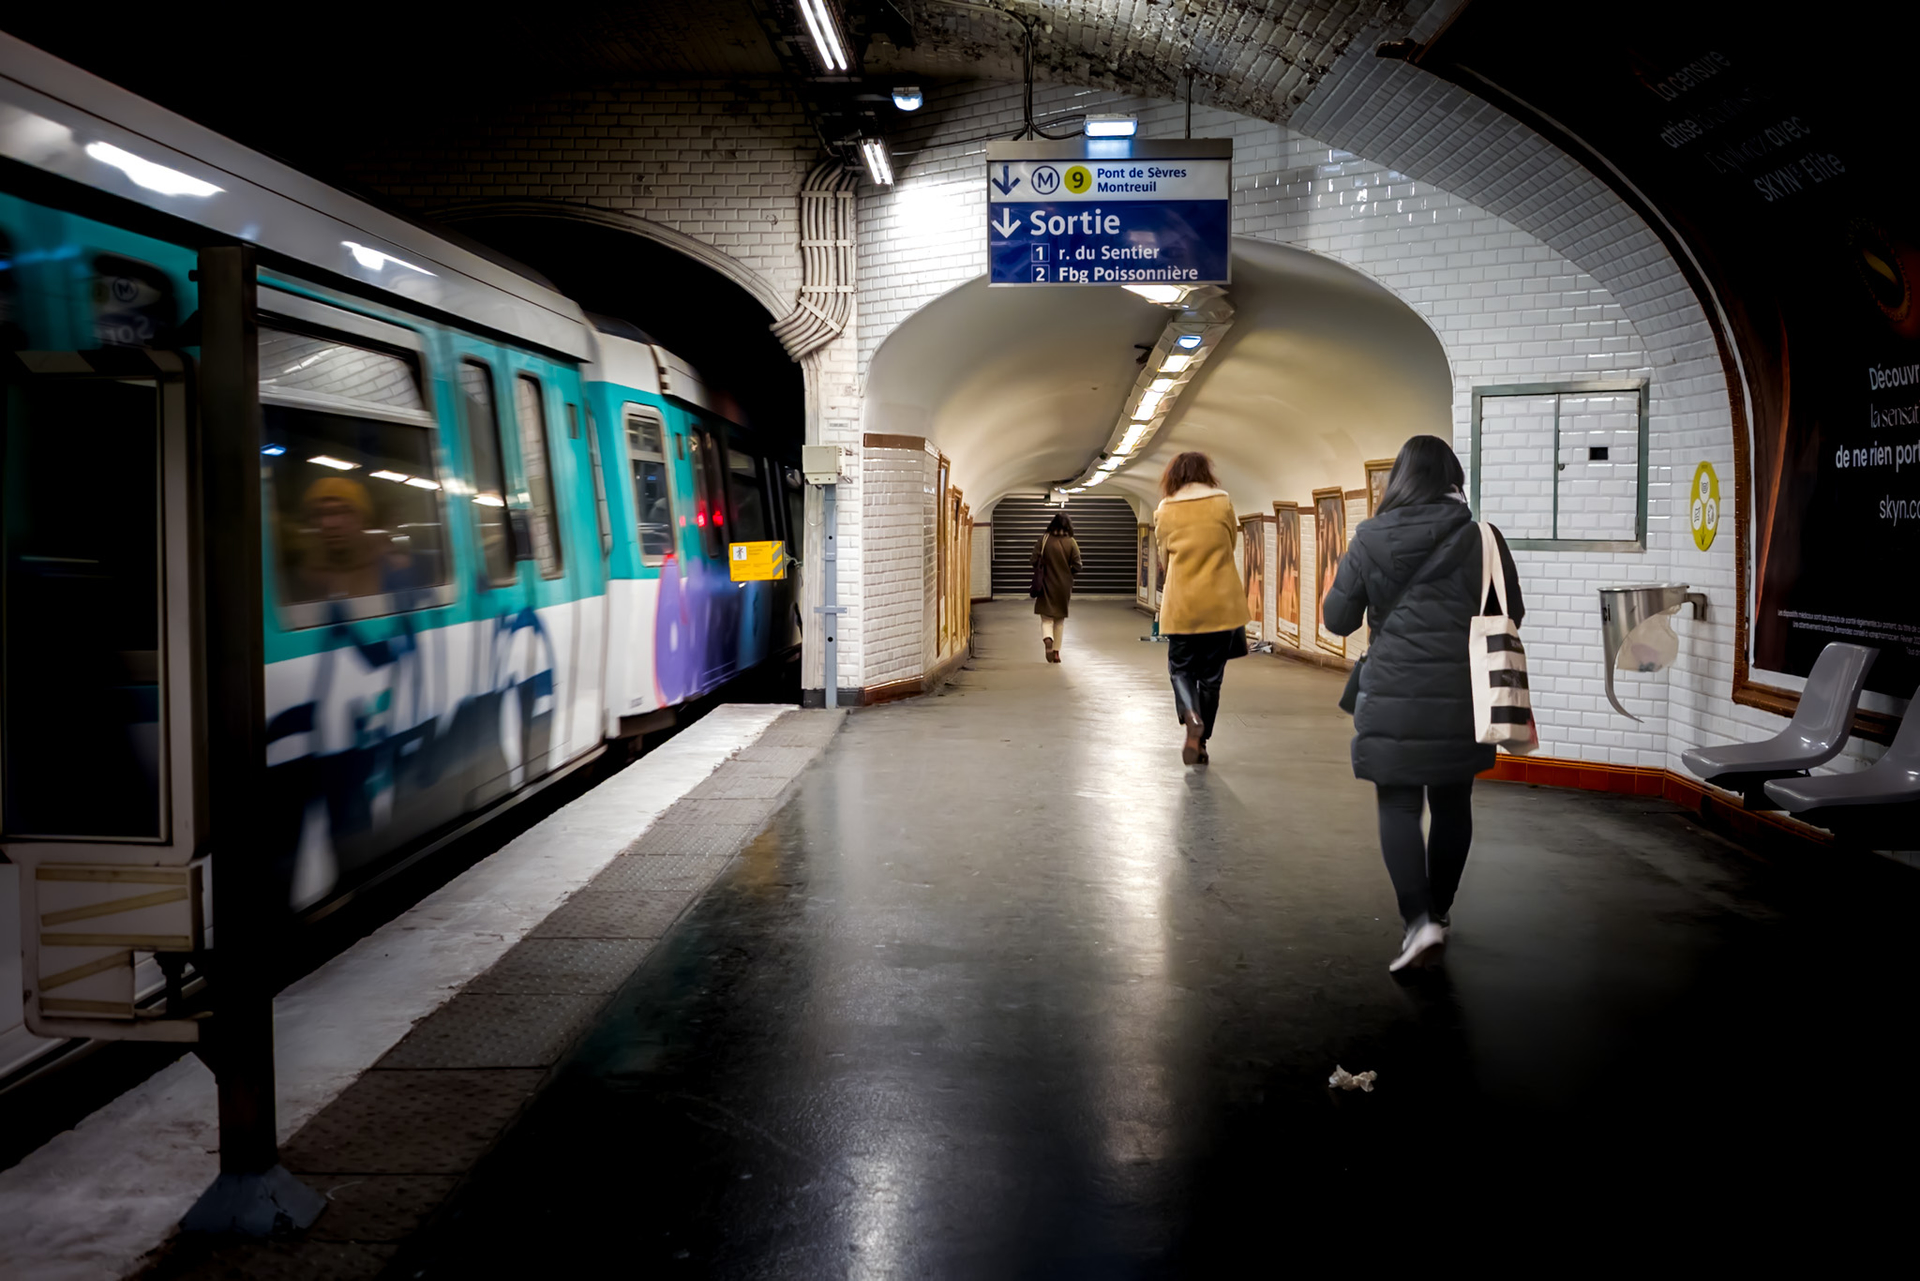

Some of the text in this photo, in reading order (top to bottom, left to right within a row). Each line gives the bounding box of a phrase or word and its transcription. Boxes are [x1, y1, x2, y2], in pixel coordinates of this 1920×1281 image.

[1667, 51, 1731, 92] censure
[1764, 115, 1811, 147] avec
[1071, 172, 1084, 189] 9
[1097, 167, 1187, 179] Pont de Sèvres
[1799, 152, 1846, 183] Elite
[1097, 182, 1157, 193] Montreuil
[1030, 209, 1121, 236] Sortie
[1059, 248, 1070, 260] r.
[1075, 246, 1096, 260] du
[1101, 245, 1160, 260] Sentier
[1035, 265, 1199, 284] 2 Fbg Poissonnière
[1868, 362, 1920, 391] Découvr
[1870, 402, 1880, 428] la
[1835, 444, 1850, 469] de
[1853, 448, 1868, 468] ne
[1869, 440, 1892, 466] rien
